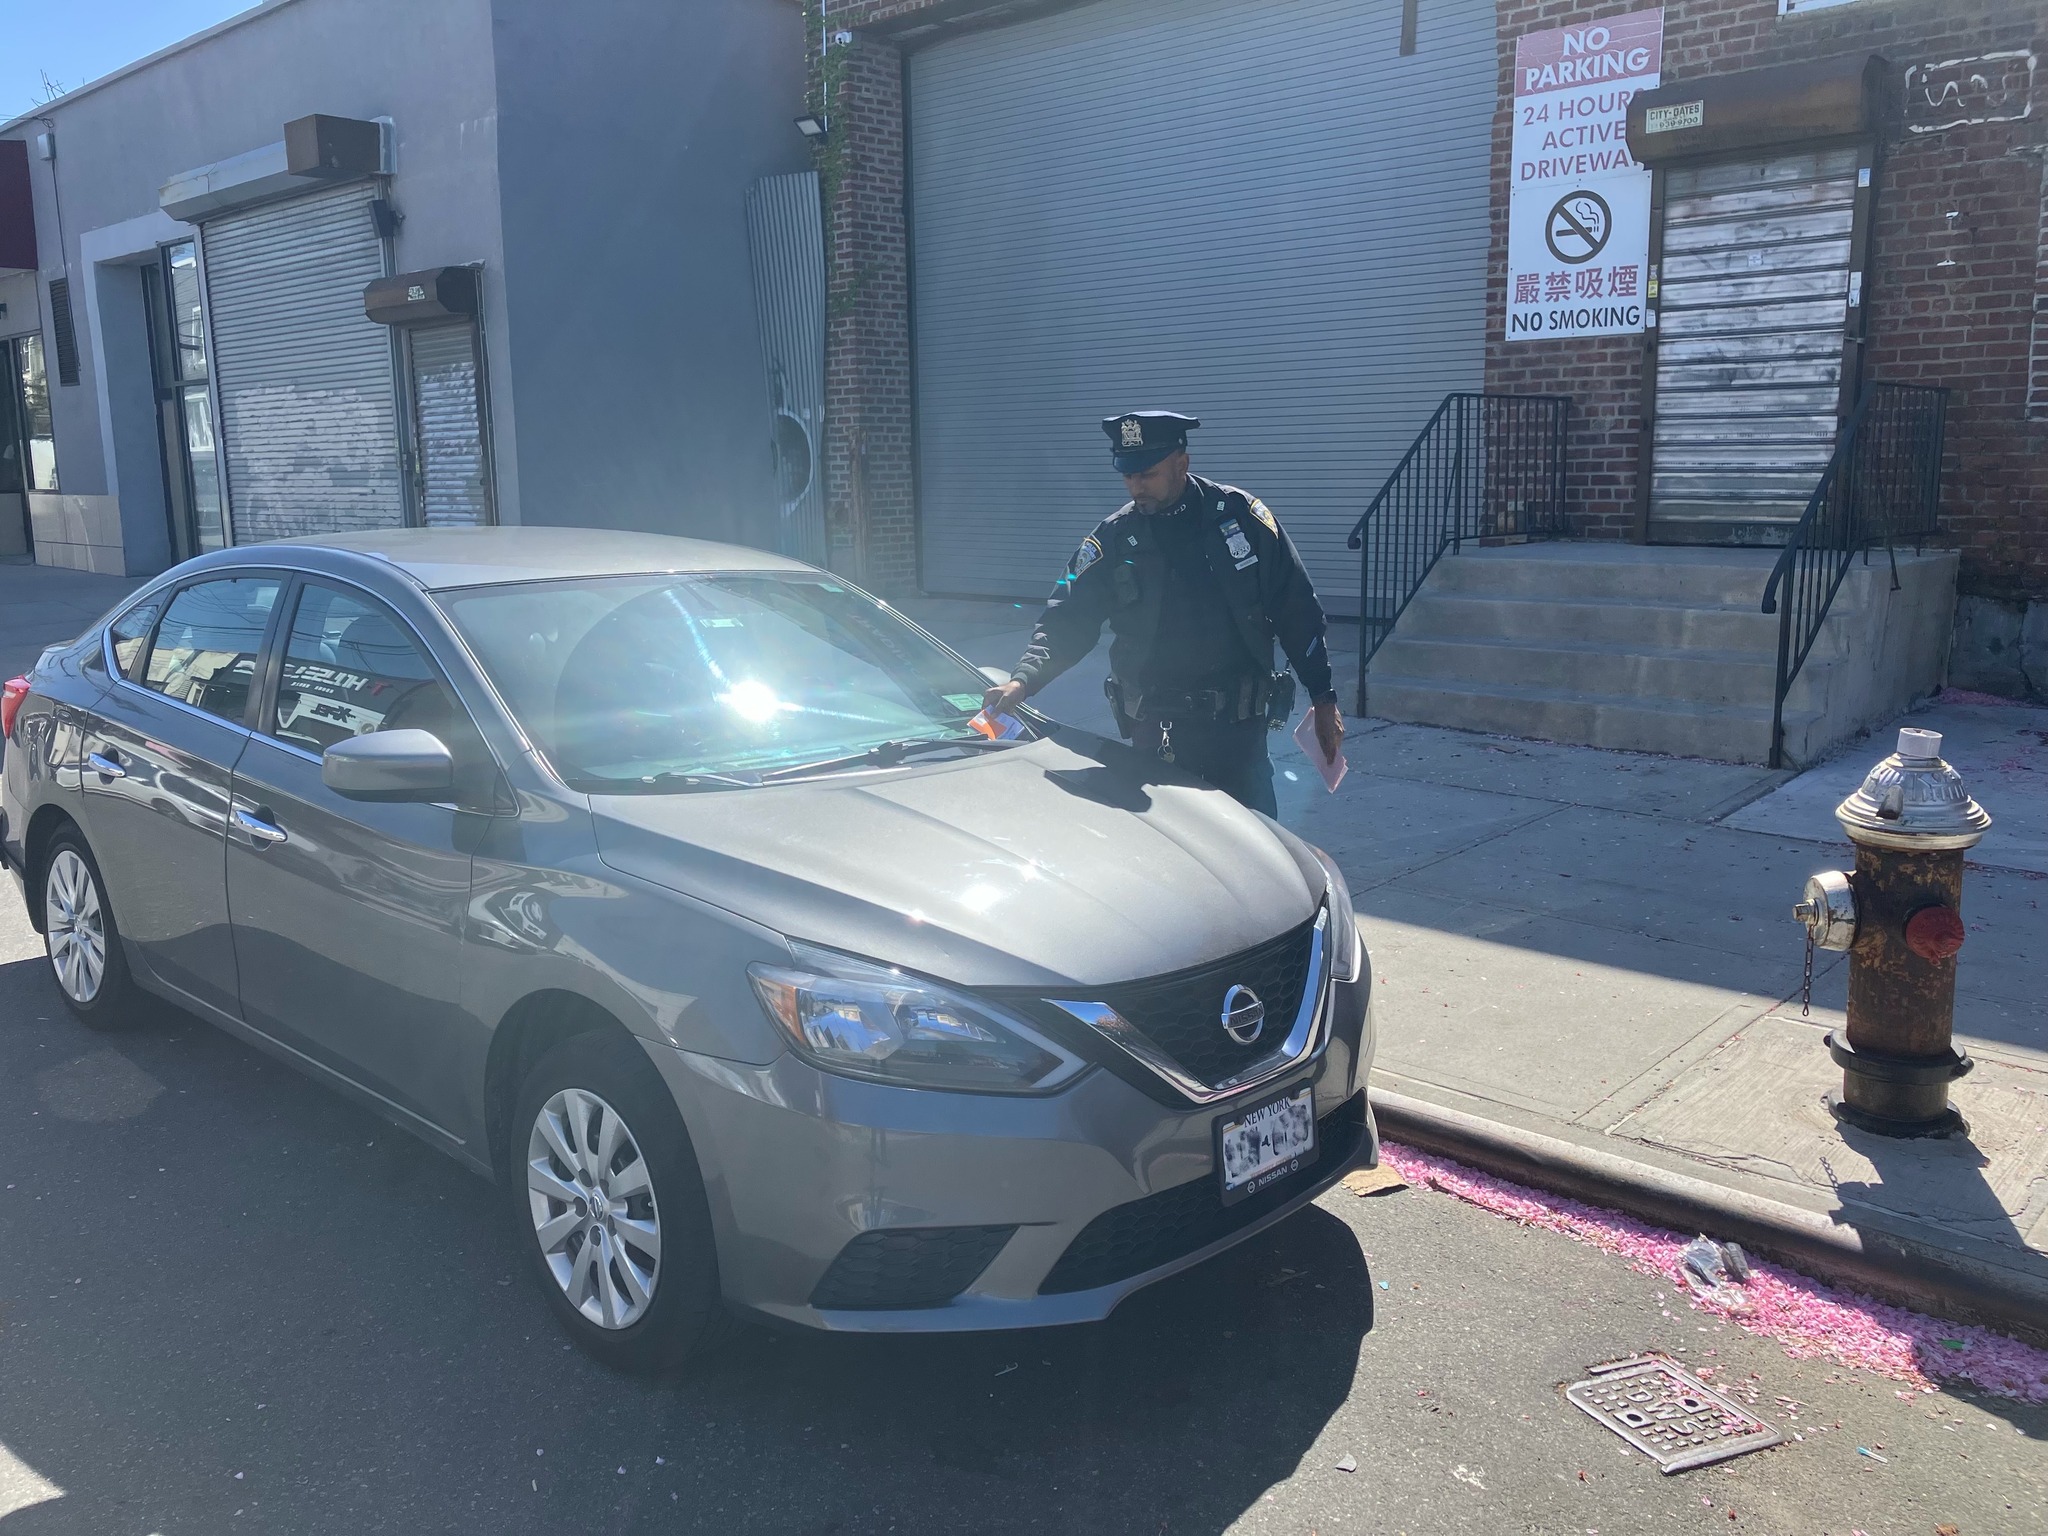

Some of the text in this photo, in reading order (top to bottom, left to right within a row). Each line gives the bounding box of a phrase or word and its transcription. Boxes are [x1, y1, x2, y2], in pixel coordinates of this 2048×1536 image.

[1563, 27, 1610, 56] NO
[1525, 47, 1650, 91] PARKING
[1523, 88, 1644, 126] 24 HOUR
[1542, 120, 1626, 150] ACTIVE
[1521, 149, 1638, 181] DRIVEWA
[1514, 265, 1639, 304] 嚴禁吸煙
[1512, 312, 1543, 332] NO
[1549, 305, 1640, 331] SMOKING
[1244, 1097, 1292, 1128] NEW YORK
[1258, 1165, 1288, 1187] NISSAN
